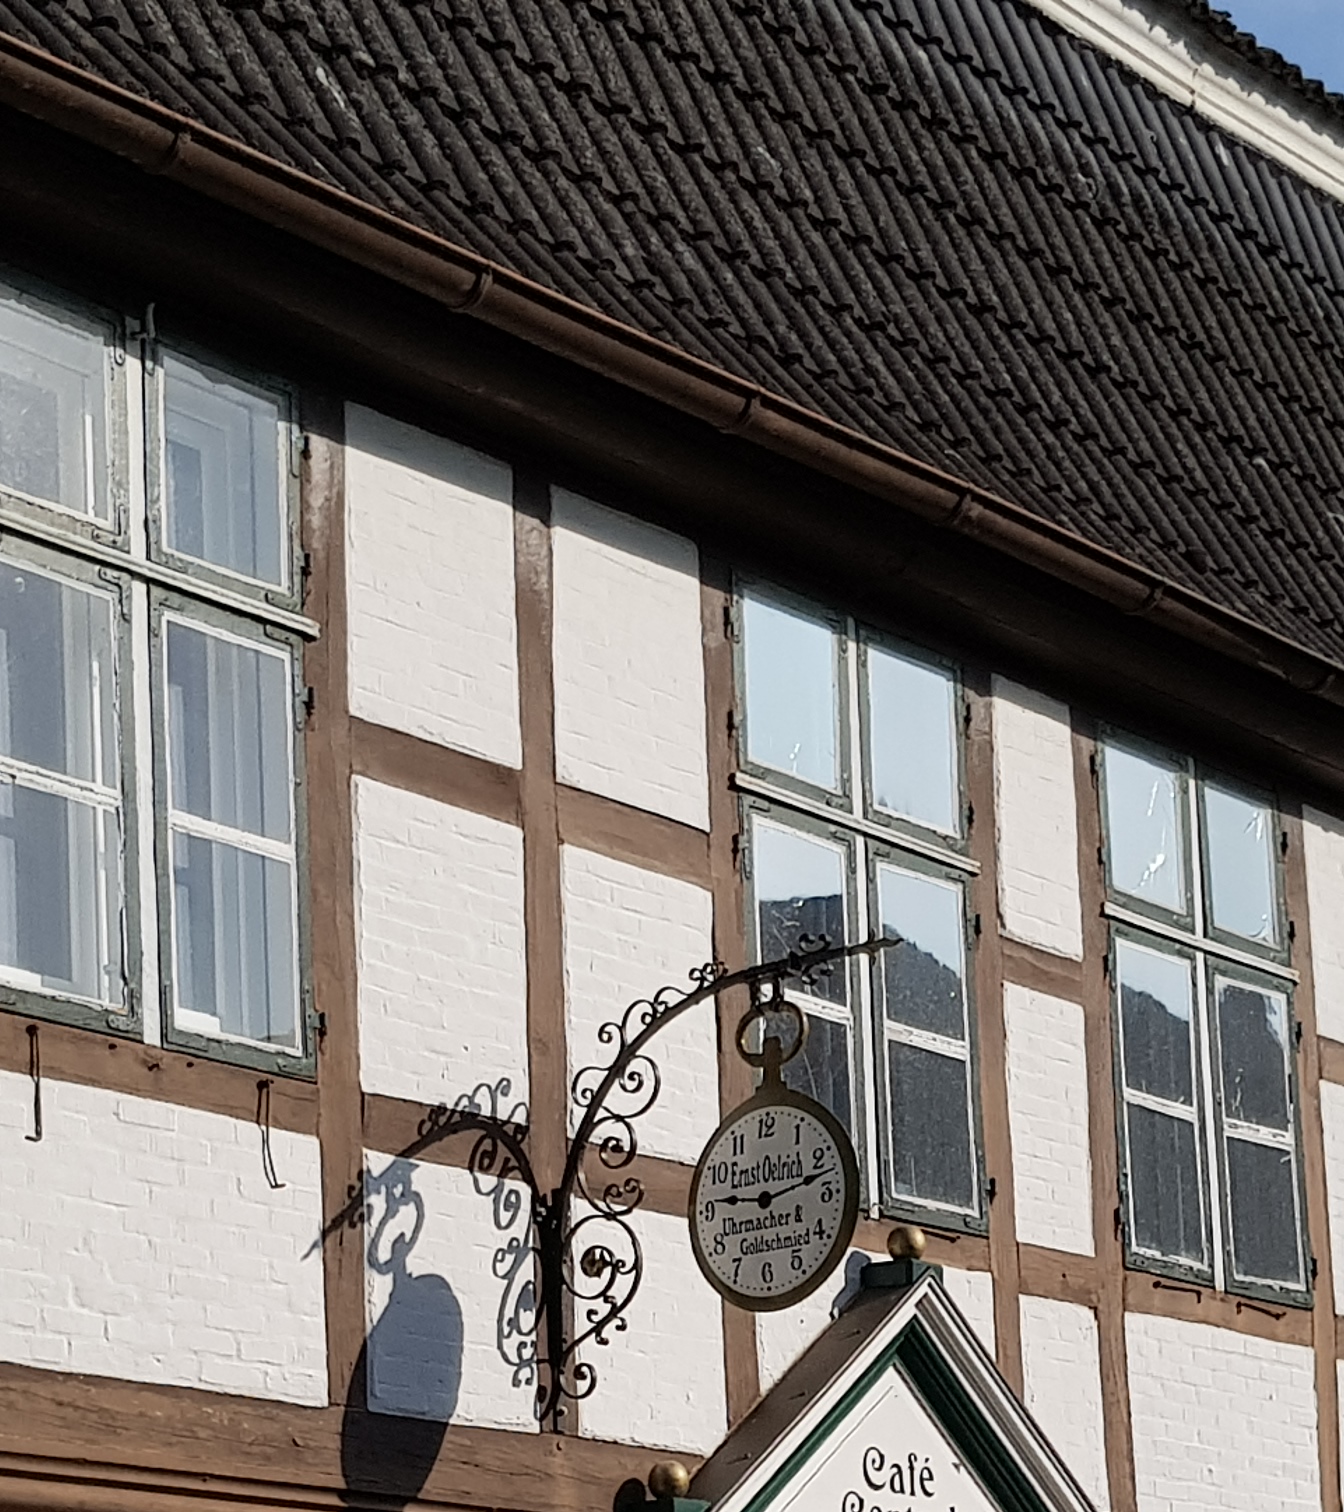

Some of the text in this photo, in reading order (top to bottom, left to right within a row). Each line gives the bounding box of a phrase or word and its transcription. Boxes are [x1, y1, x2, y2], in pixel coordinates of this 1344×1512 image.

[758, 1115, 775, 1139] 12
[794, 1123, 801, 1145] 1
[732, 1134, 745, 1156] 11
[731, 1151, 803, 1189] Ernst Oelrich
[812, 1148, 824, 1170] 2
[711, 1161, 728, 1185] 10
[821, 1181, 833, 1204] 3
[705, 1200, 715, 1222] 9
[722, 1204, 803, 1237] Uhrmacher &
[813, 1218, 826, 1241] 4
[713, 1232, 726, 1255] 8
[740, 1227, 810, 1256] Goldschmied
[731, 1257, 742, 1280] 7
[790, 1248, 802, 1271] 5
[761, 1261, 773, 1283] 6
[862, 1446, 935, 1498] Café
